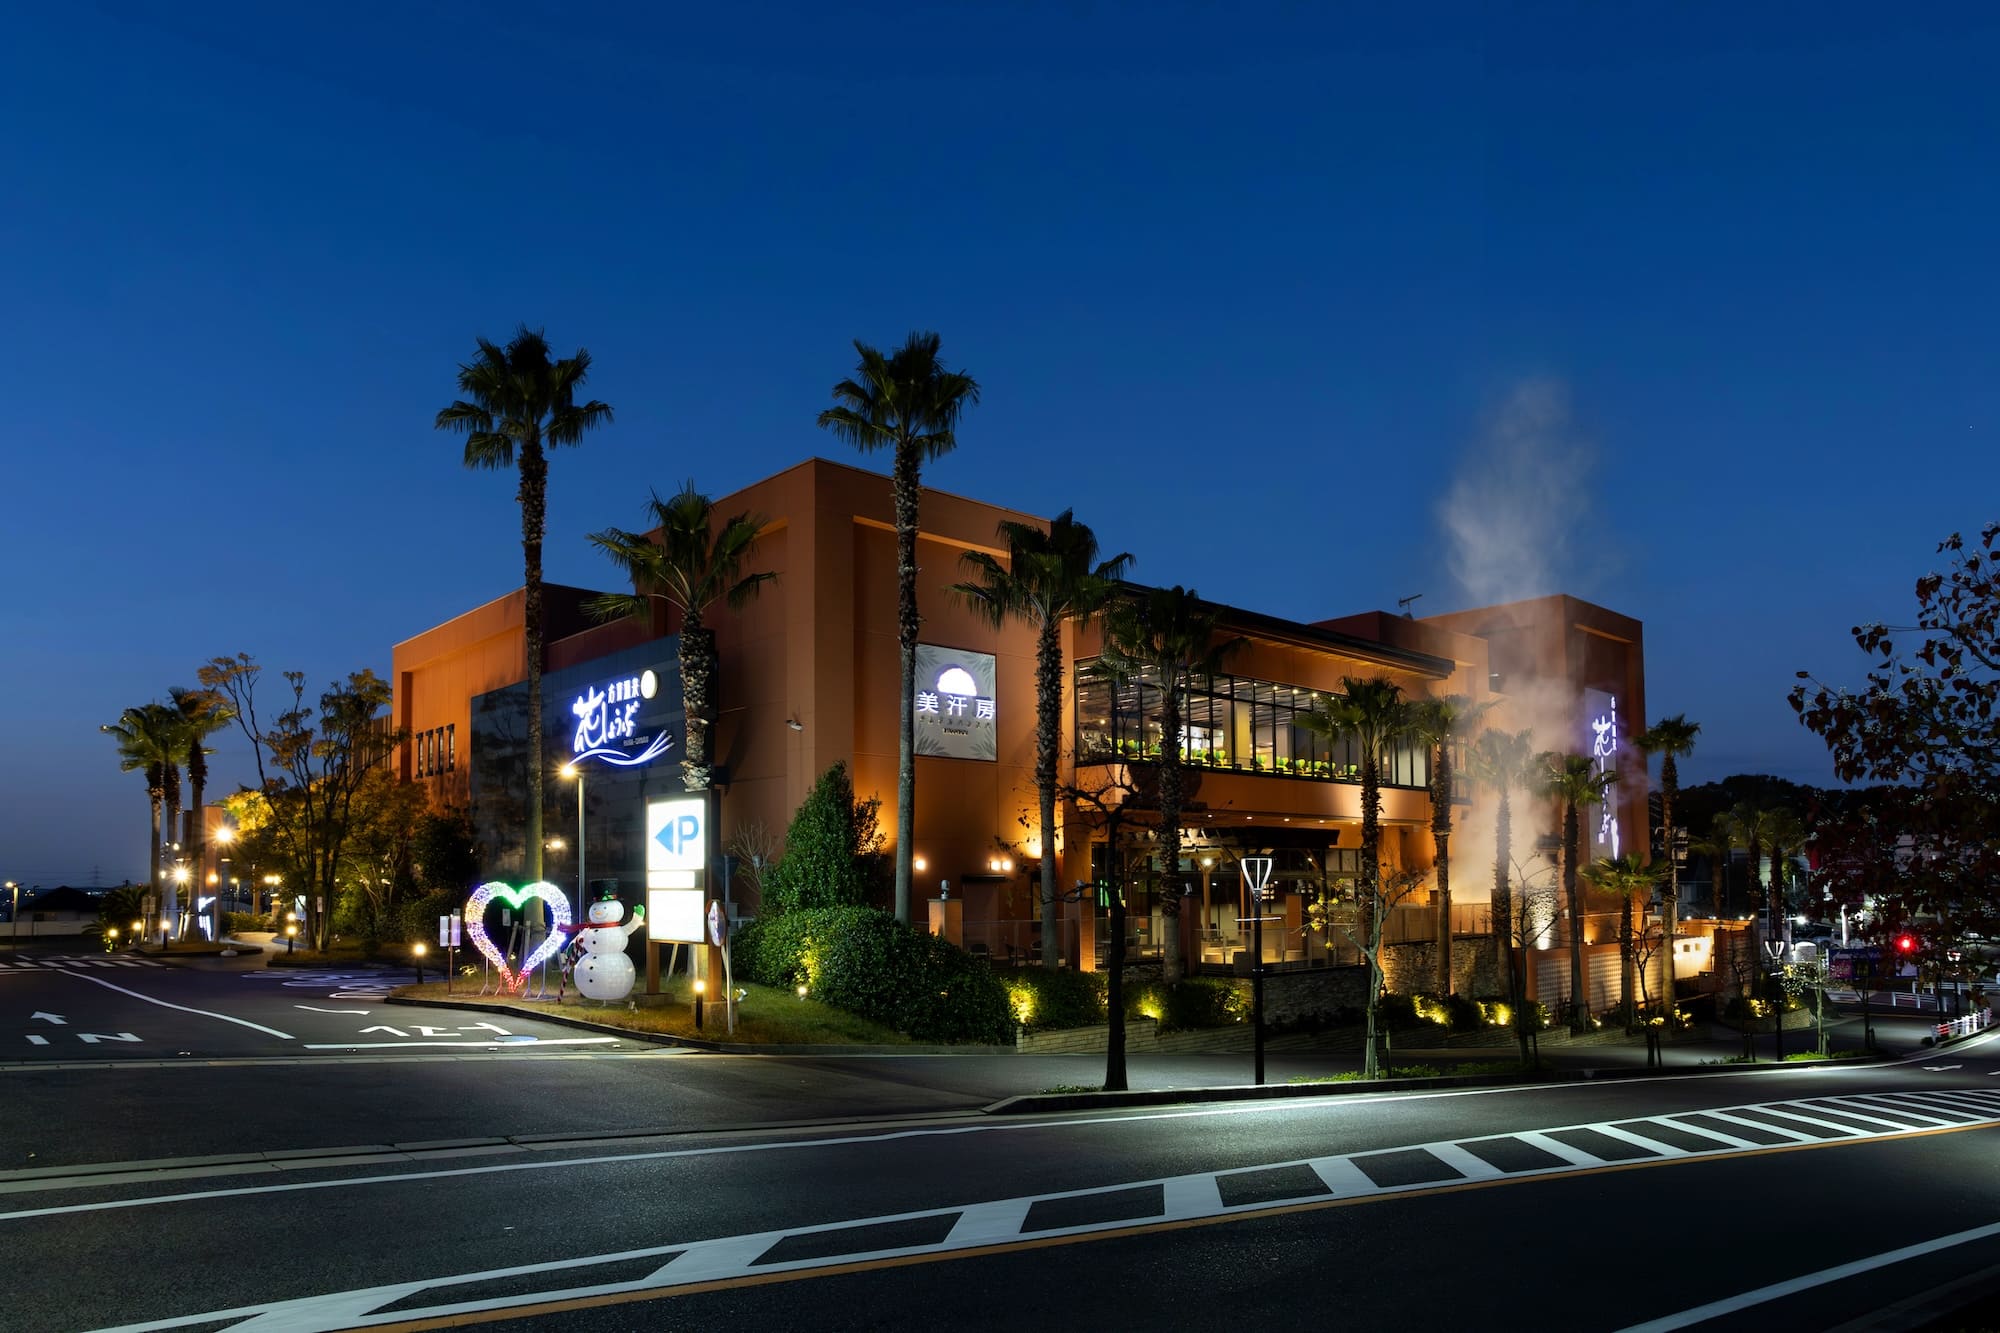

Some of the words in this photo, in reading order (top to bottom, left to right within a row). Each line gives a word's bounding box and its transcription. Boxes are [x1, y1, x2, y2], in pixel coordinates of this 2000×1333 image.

[917, 691, 995, 720] 美汗房
[678, 815, 699, 855] P
